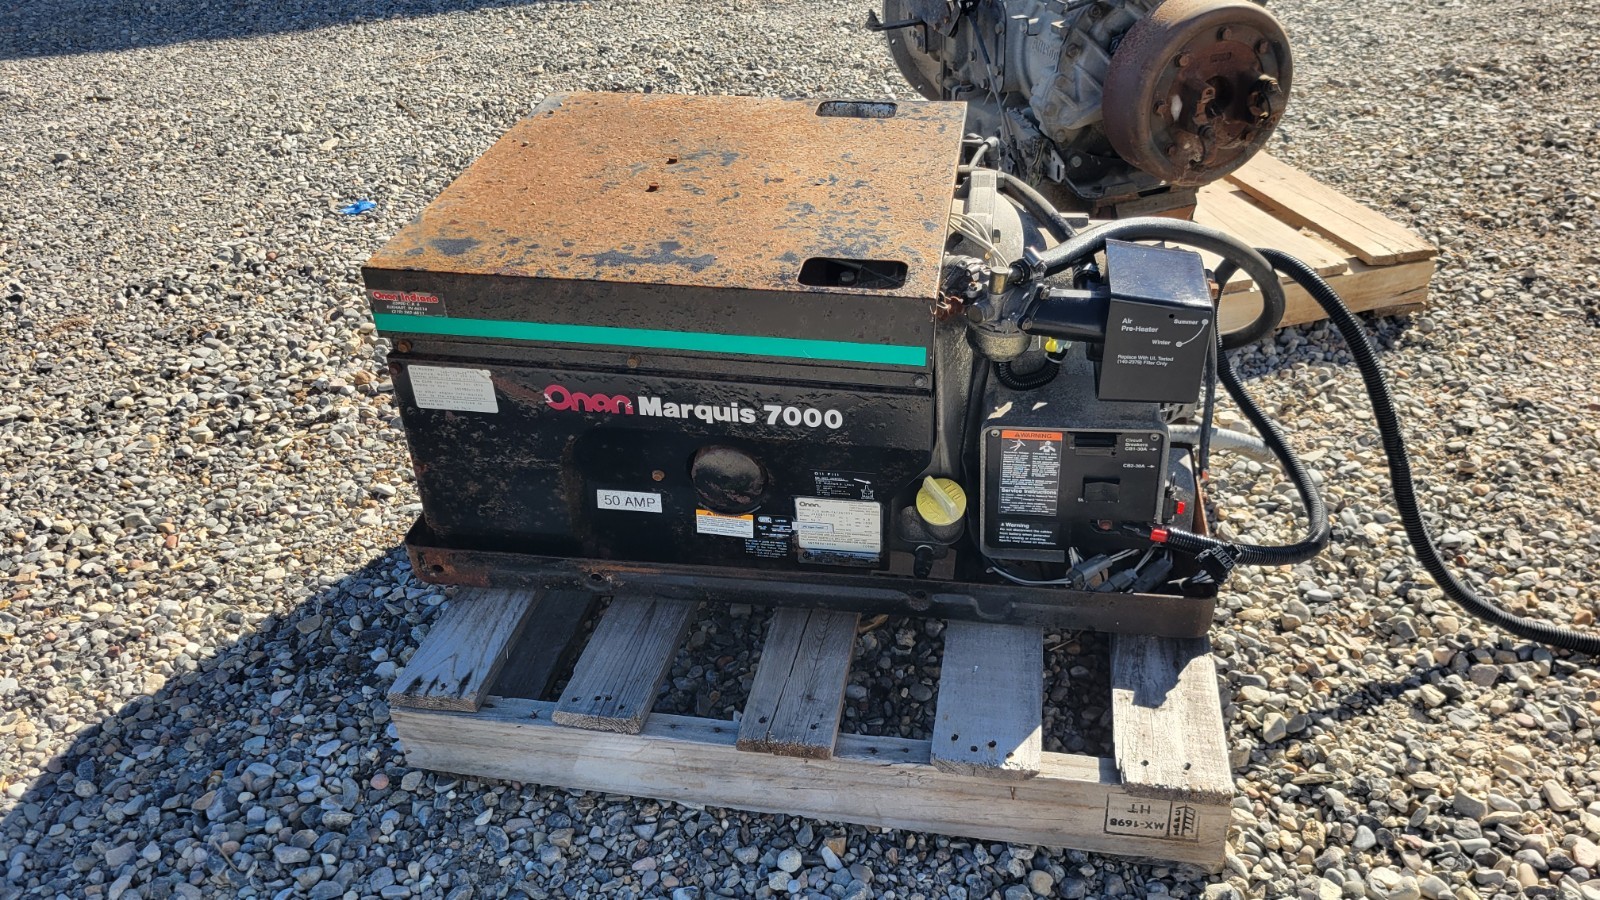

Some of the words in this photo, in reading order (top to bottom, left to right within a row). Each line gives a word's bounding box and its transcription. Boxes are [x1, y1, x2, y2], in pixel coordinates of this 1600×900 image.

[373, 291, 397, 301] Onan
[400, 292, 439, 303] Indiana
[544, 384, 634, 415] Onan
[638, 396, 757, 424] Marquis
[763, 404, 843, 429] 7000
[604, 495, 620, 505] 50
[625, 497, 655, 507] AMP
[1127, 804, 1151, 814] HT
[1110, 818, 1165, 830] MX-1698
